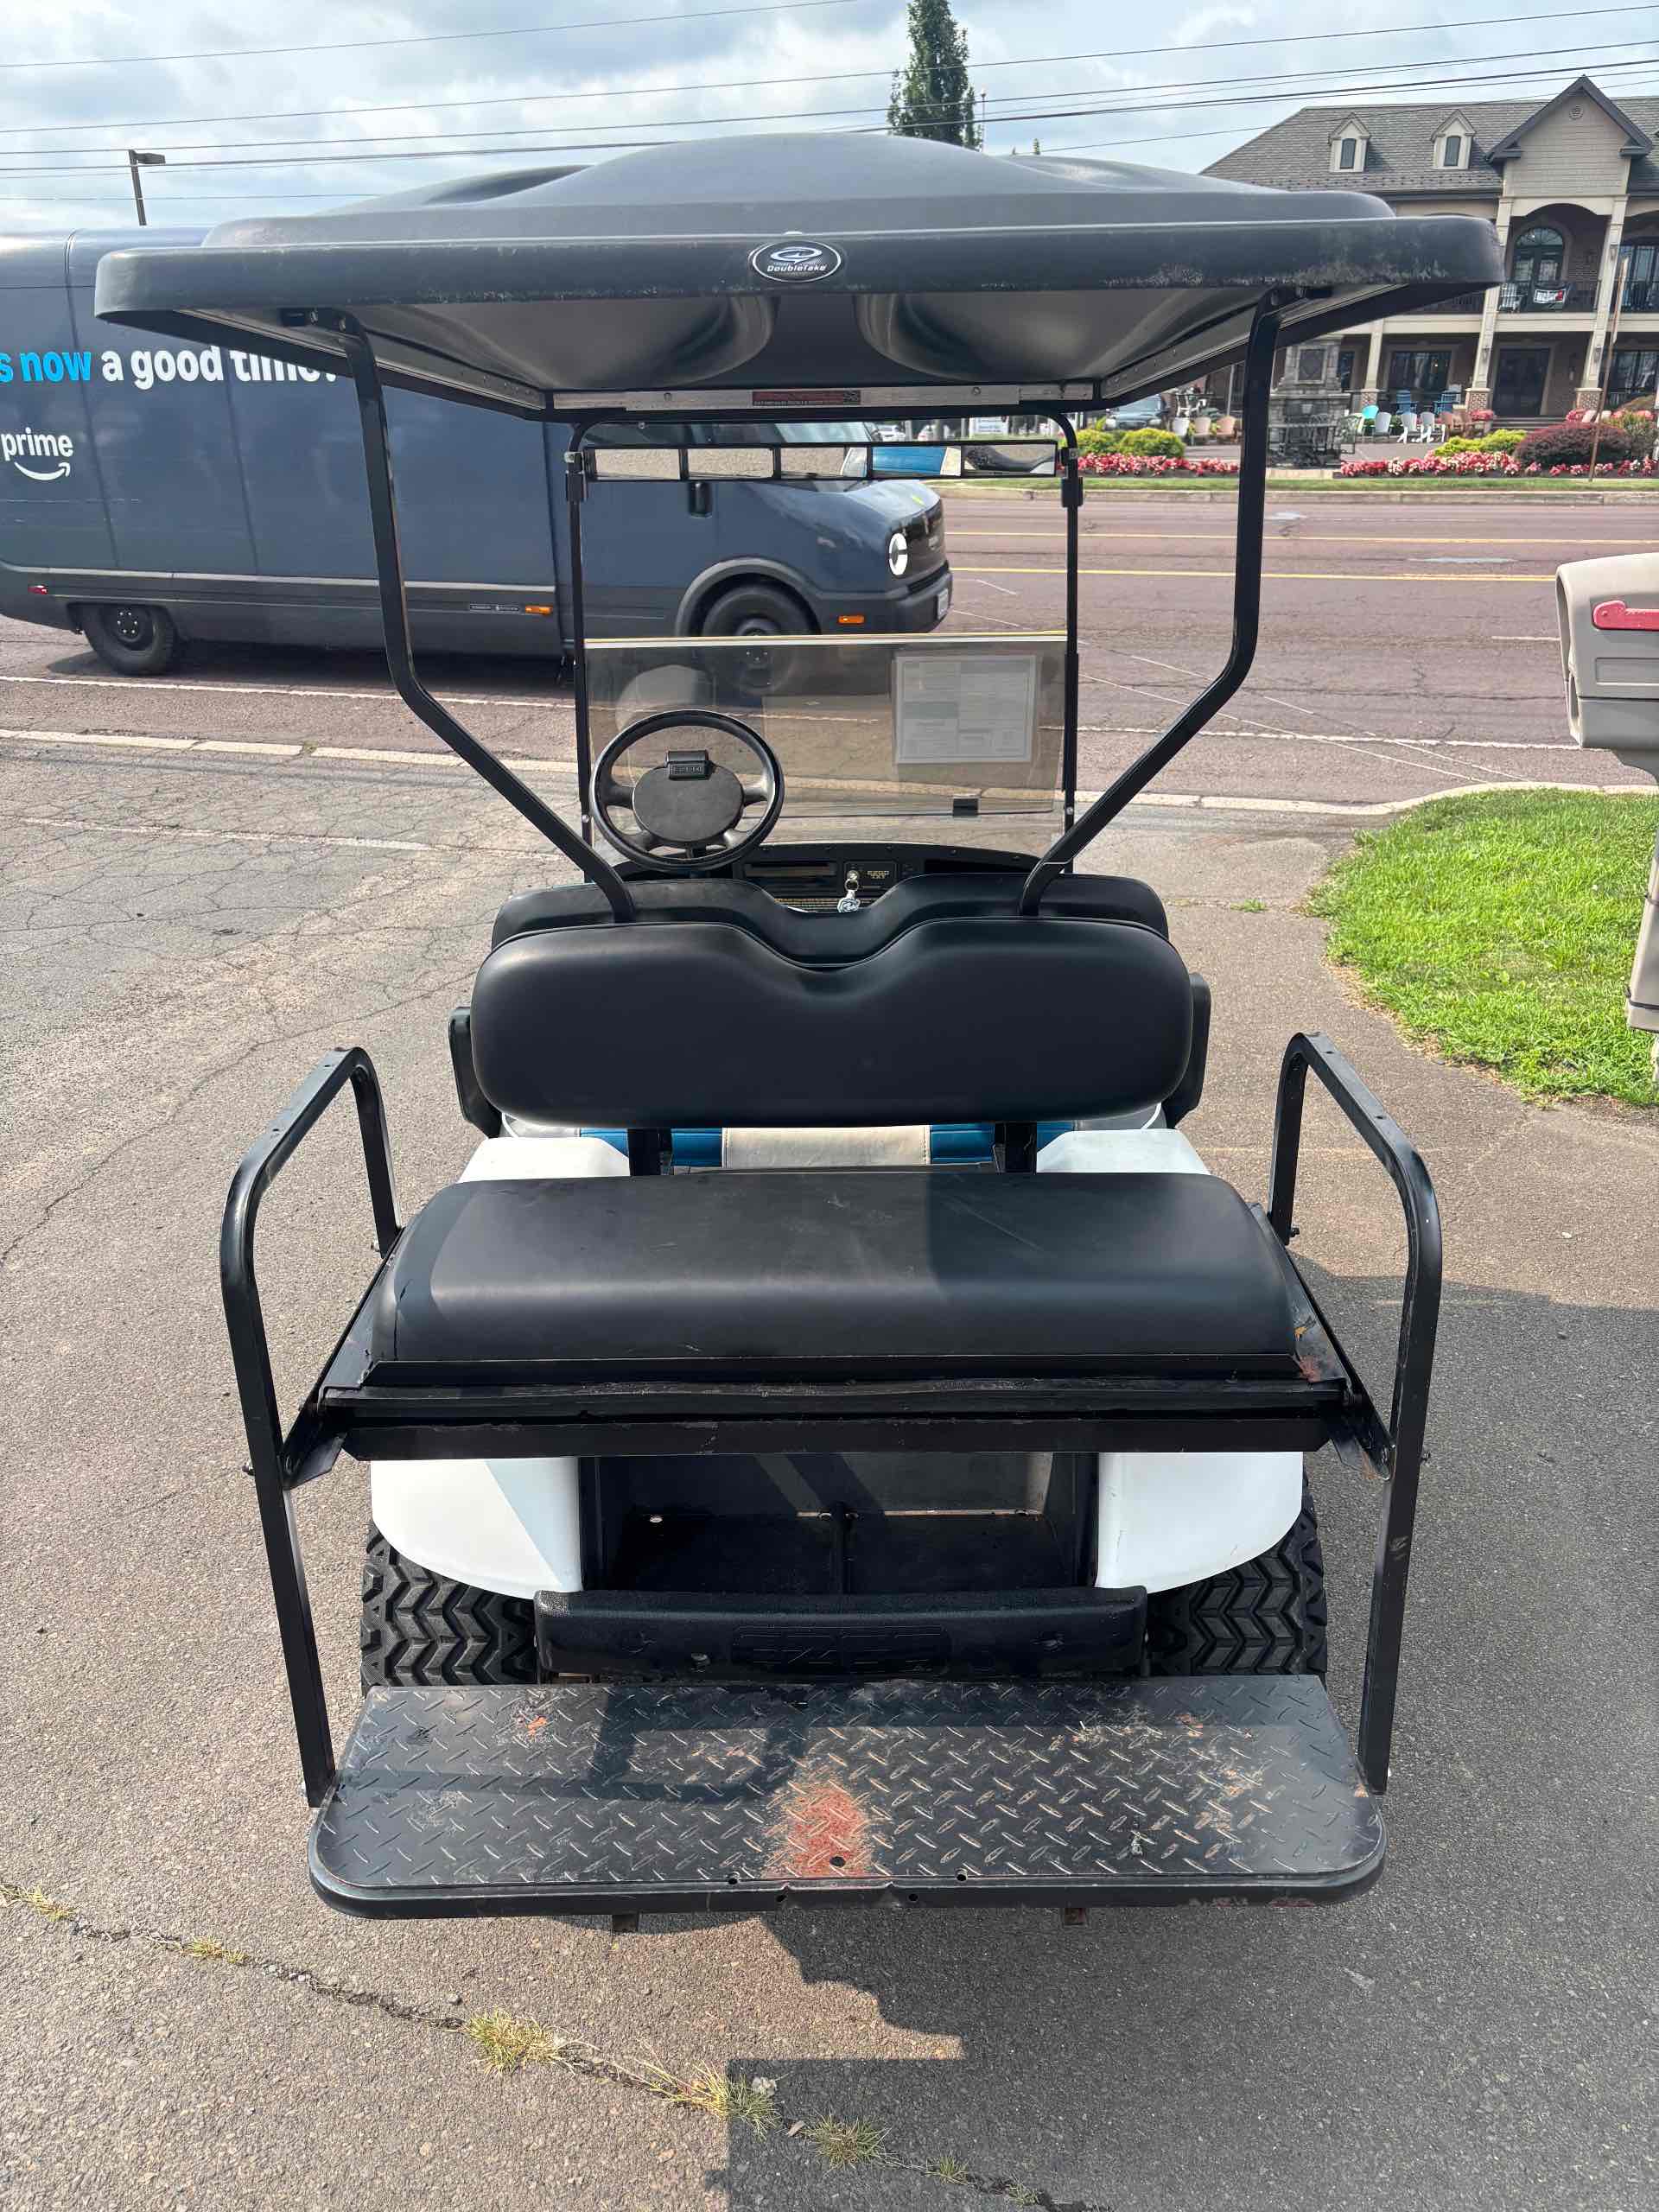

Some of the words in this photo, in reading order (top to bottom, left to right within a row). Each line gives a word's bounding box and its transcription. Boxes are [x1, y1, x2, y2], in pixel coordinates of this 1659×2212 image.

[20, 351, 92, 382] now
[101, 350, 124, 382] a
[130, 345, 224, 390] good
[228, 349, 336, 382] tim
[1, 426, 73, 461] prime
